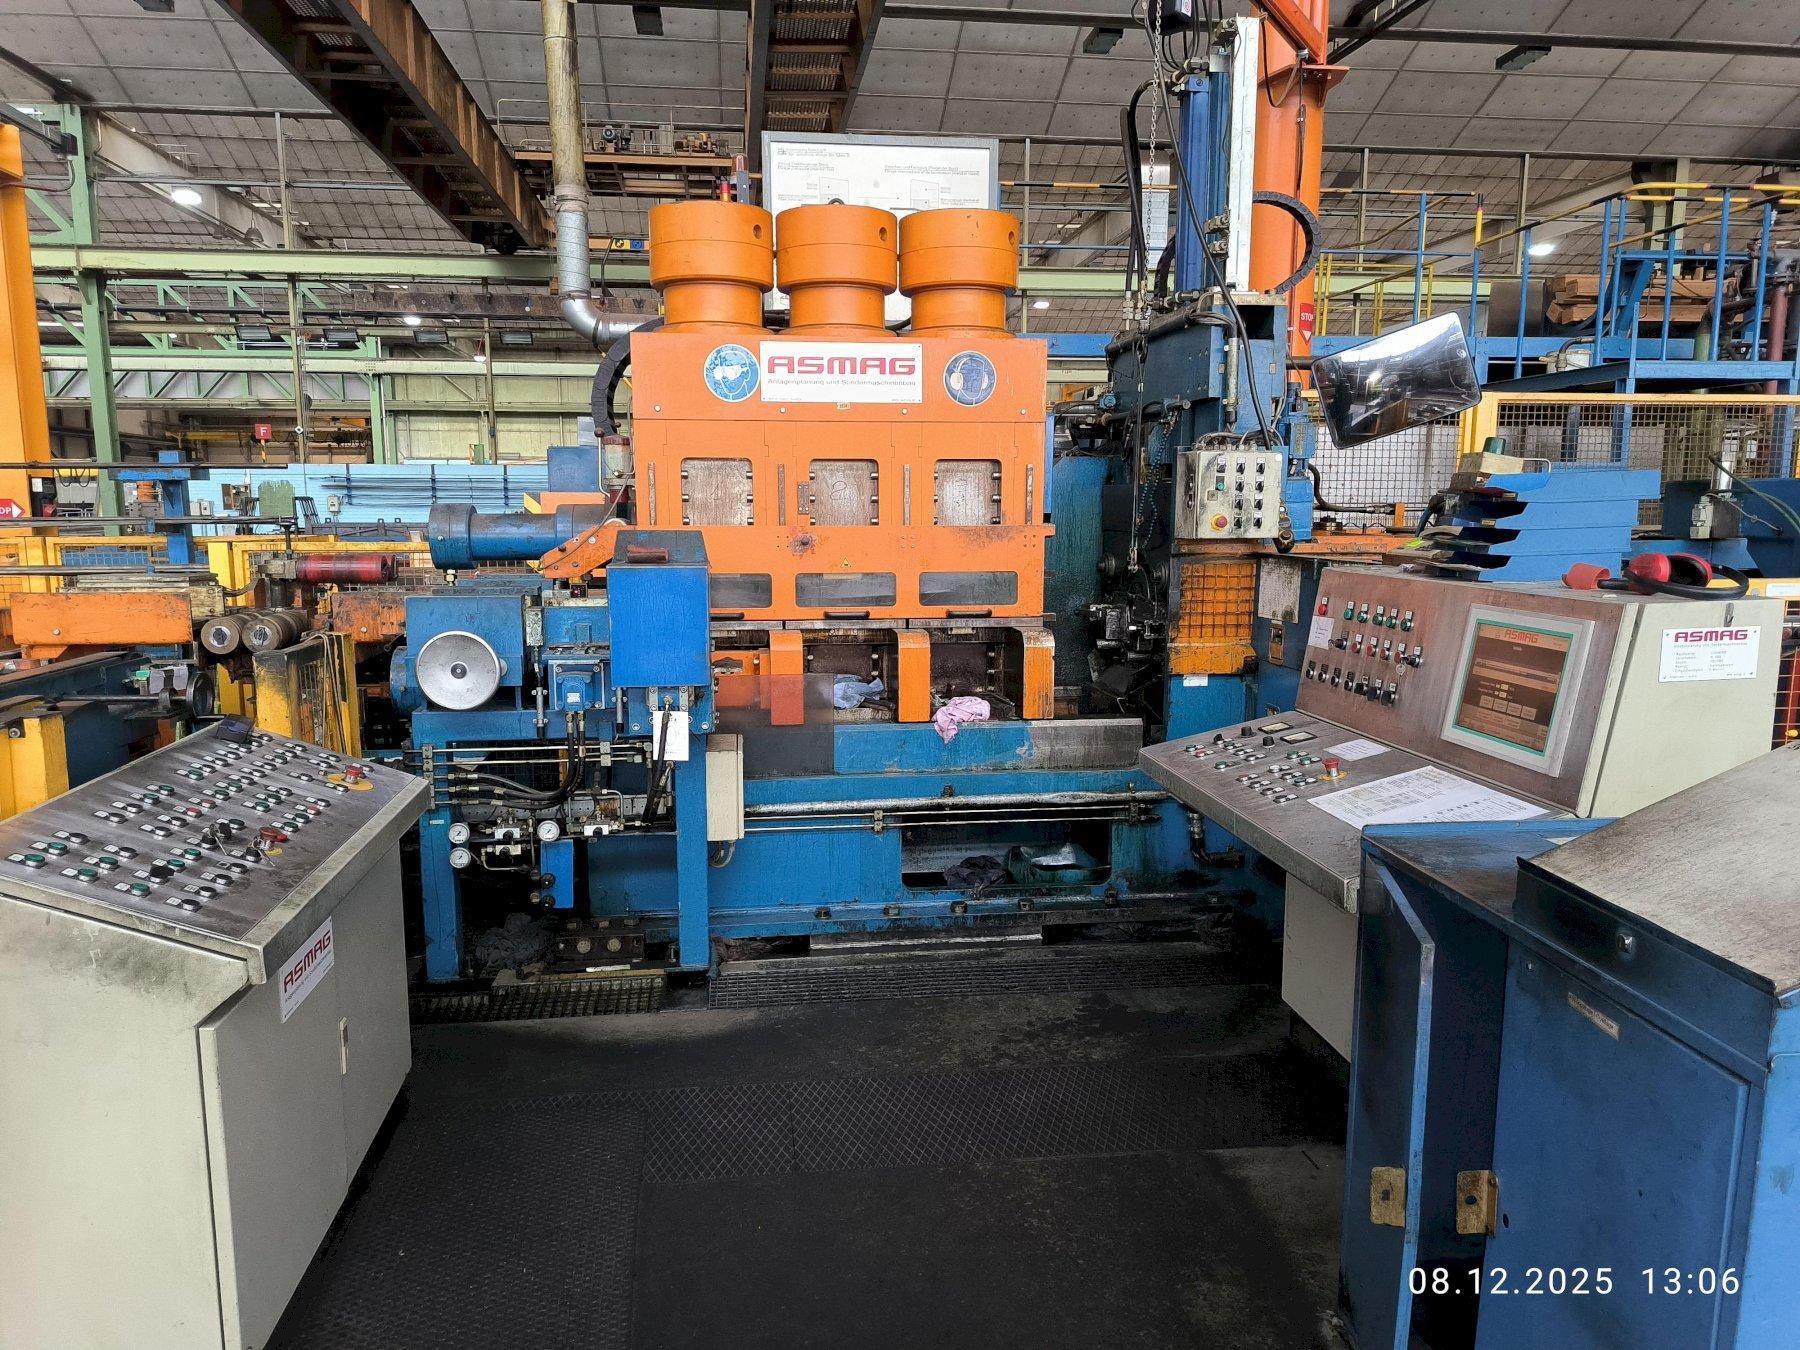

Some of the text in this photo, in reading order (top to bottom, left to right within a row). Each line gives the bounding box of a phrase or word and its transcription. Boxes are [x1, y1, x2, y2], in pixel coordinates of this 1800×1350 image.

[767, 356, 916, 375] ASMAG
[260, 427, 268, 437] F
[1503, 629, 1539, 644] ASMAG
[1674, 629, 1748, 642] ASMAG
[284, 930, 331, 993] ASMAG
